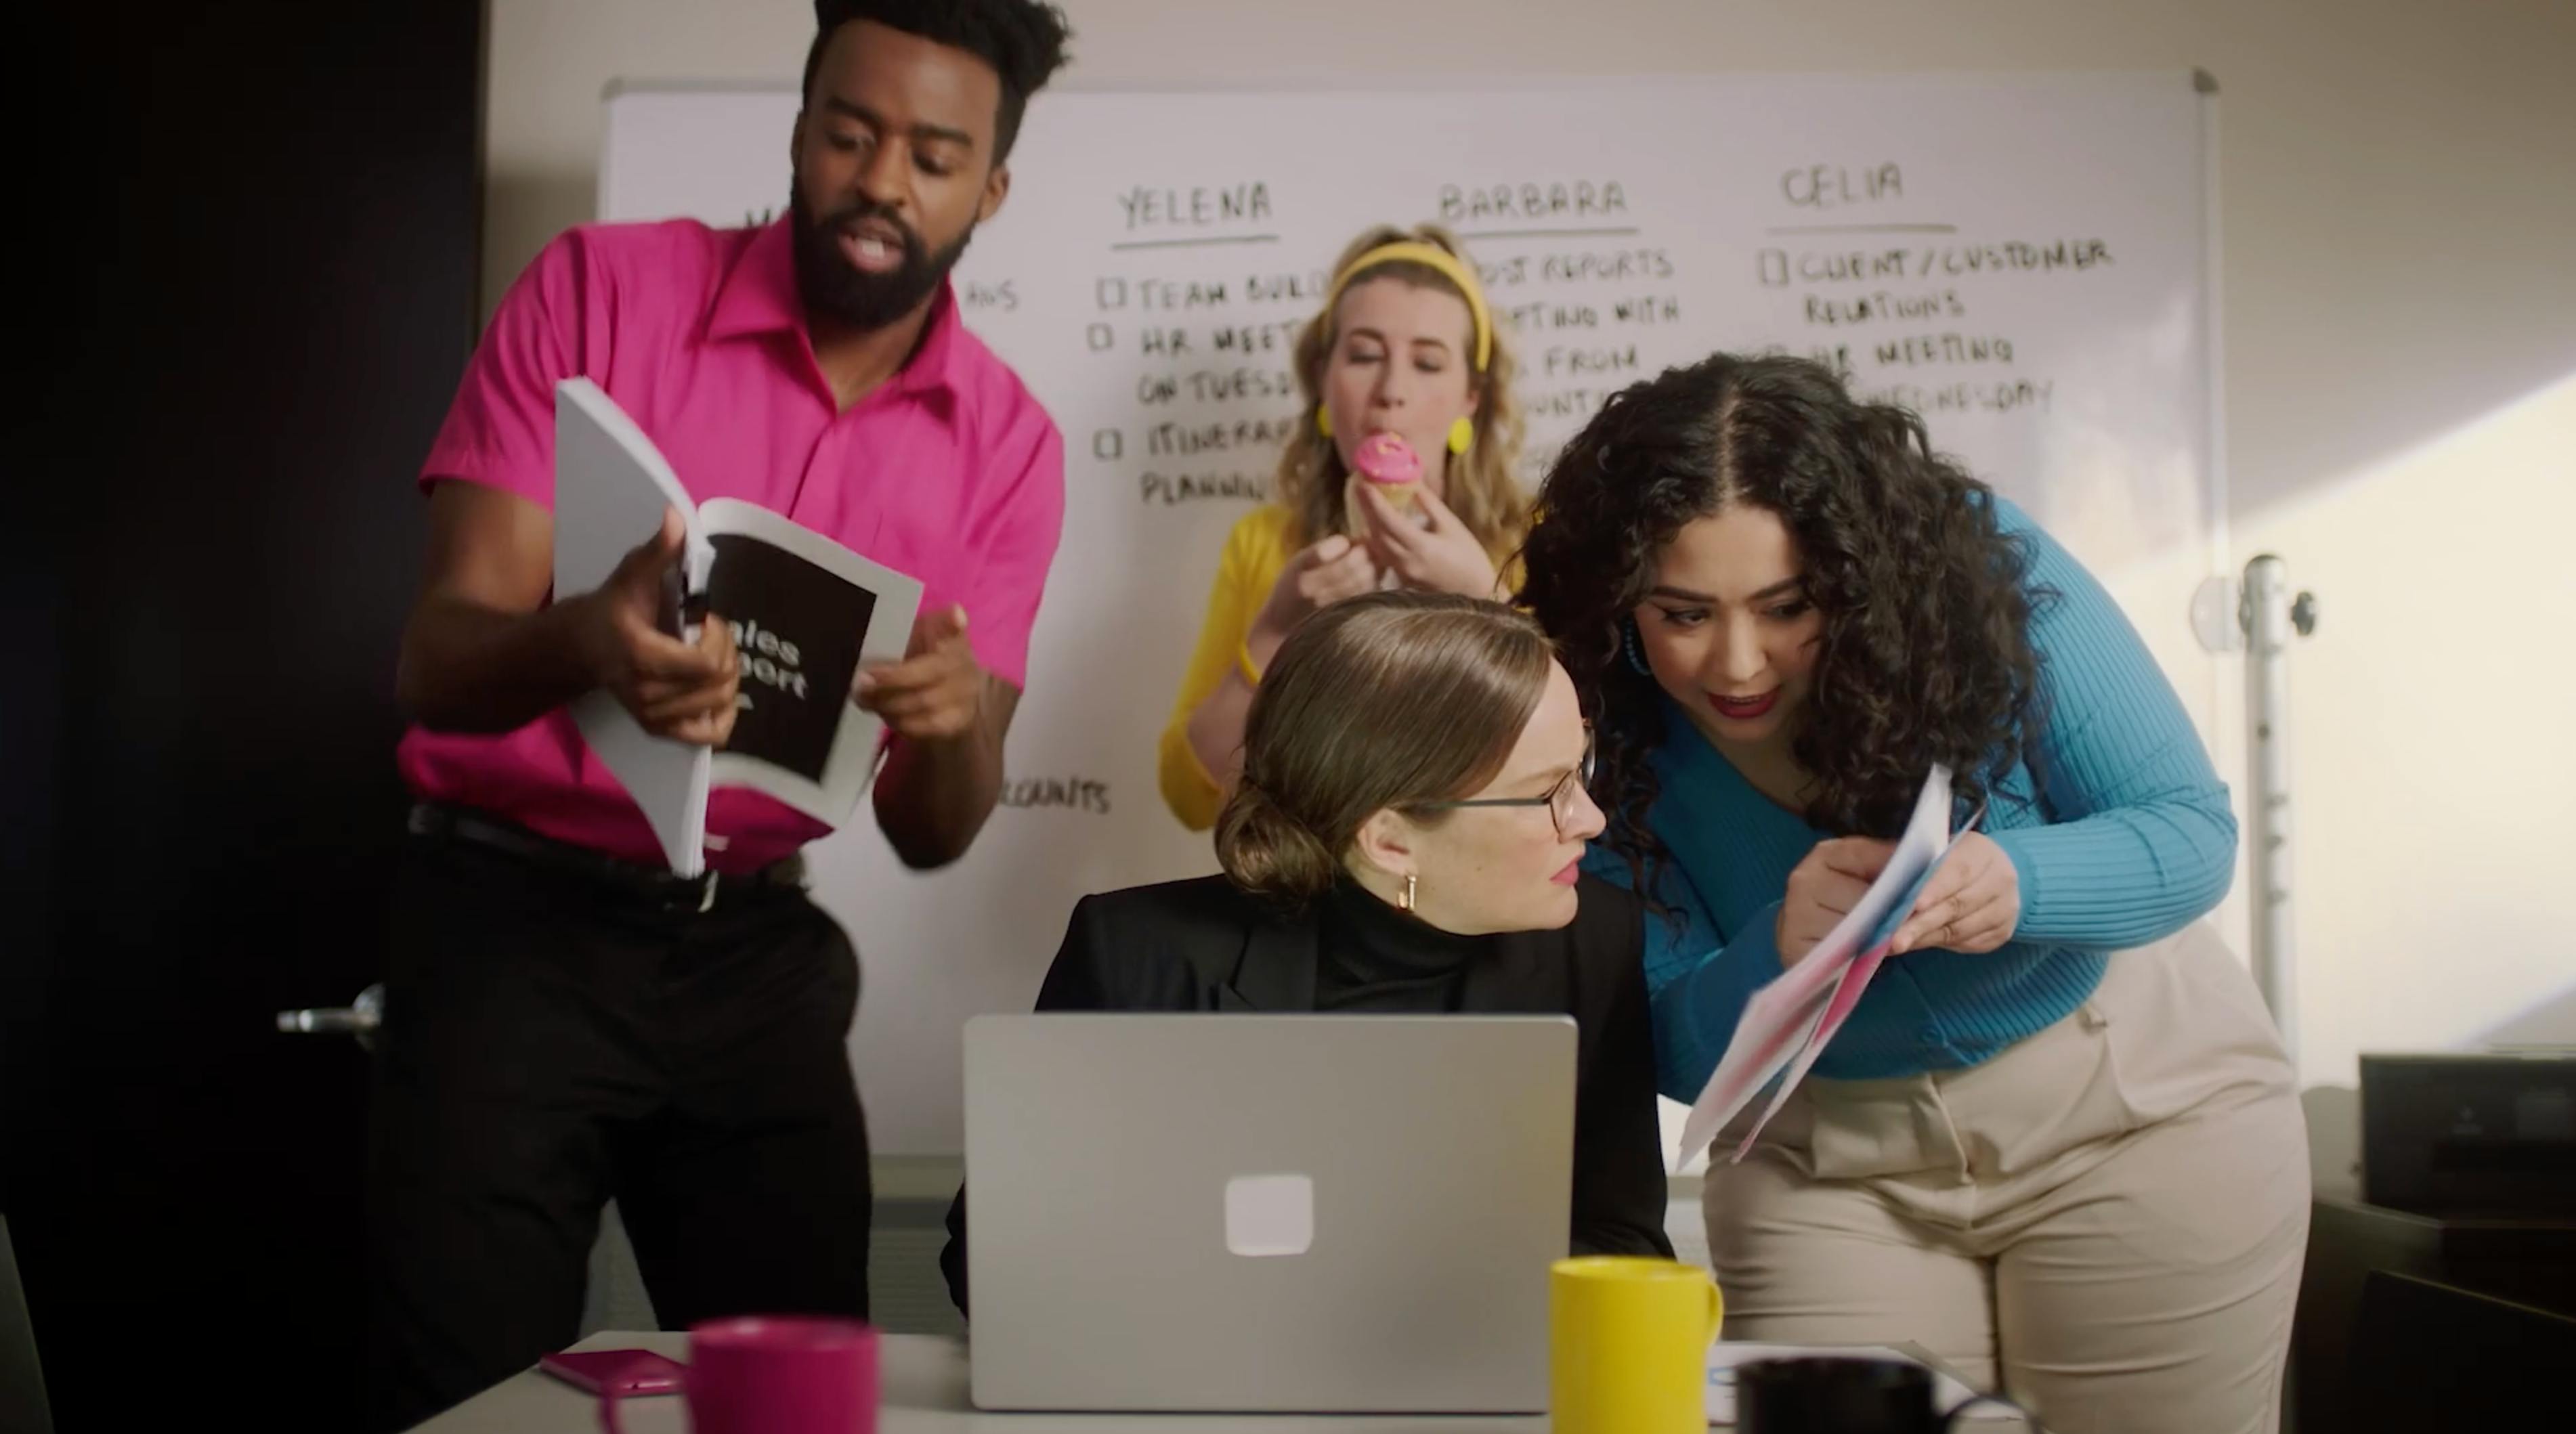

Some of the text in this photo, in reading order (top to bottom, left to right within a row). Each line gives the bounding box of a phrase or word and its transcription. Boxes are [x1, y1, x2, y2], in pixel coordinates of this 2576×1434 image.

[1439, 180, 1629, 221] BARBARA
[1781, 162, 1903, 207] CELIA
[1118, 181, 1273, 228] YELENA
[1541, 248, 1676, 282] REPORTS
[1137, 277, 1230, 310] TEAM
[1612, 295, 1681, 326] WITH
[1804, 290, 1966, 325] RELATIONS
[1139, 318, 1300, 358] HR MEET
[1874, 332, 2014, 368] MEETING
[1543, 343, 1639, 377] FROM
[727, 617, 801, 668] ales
